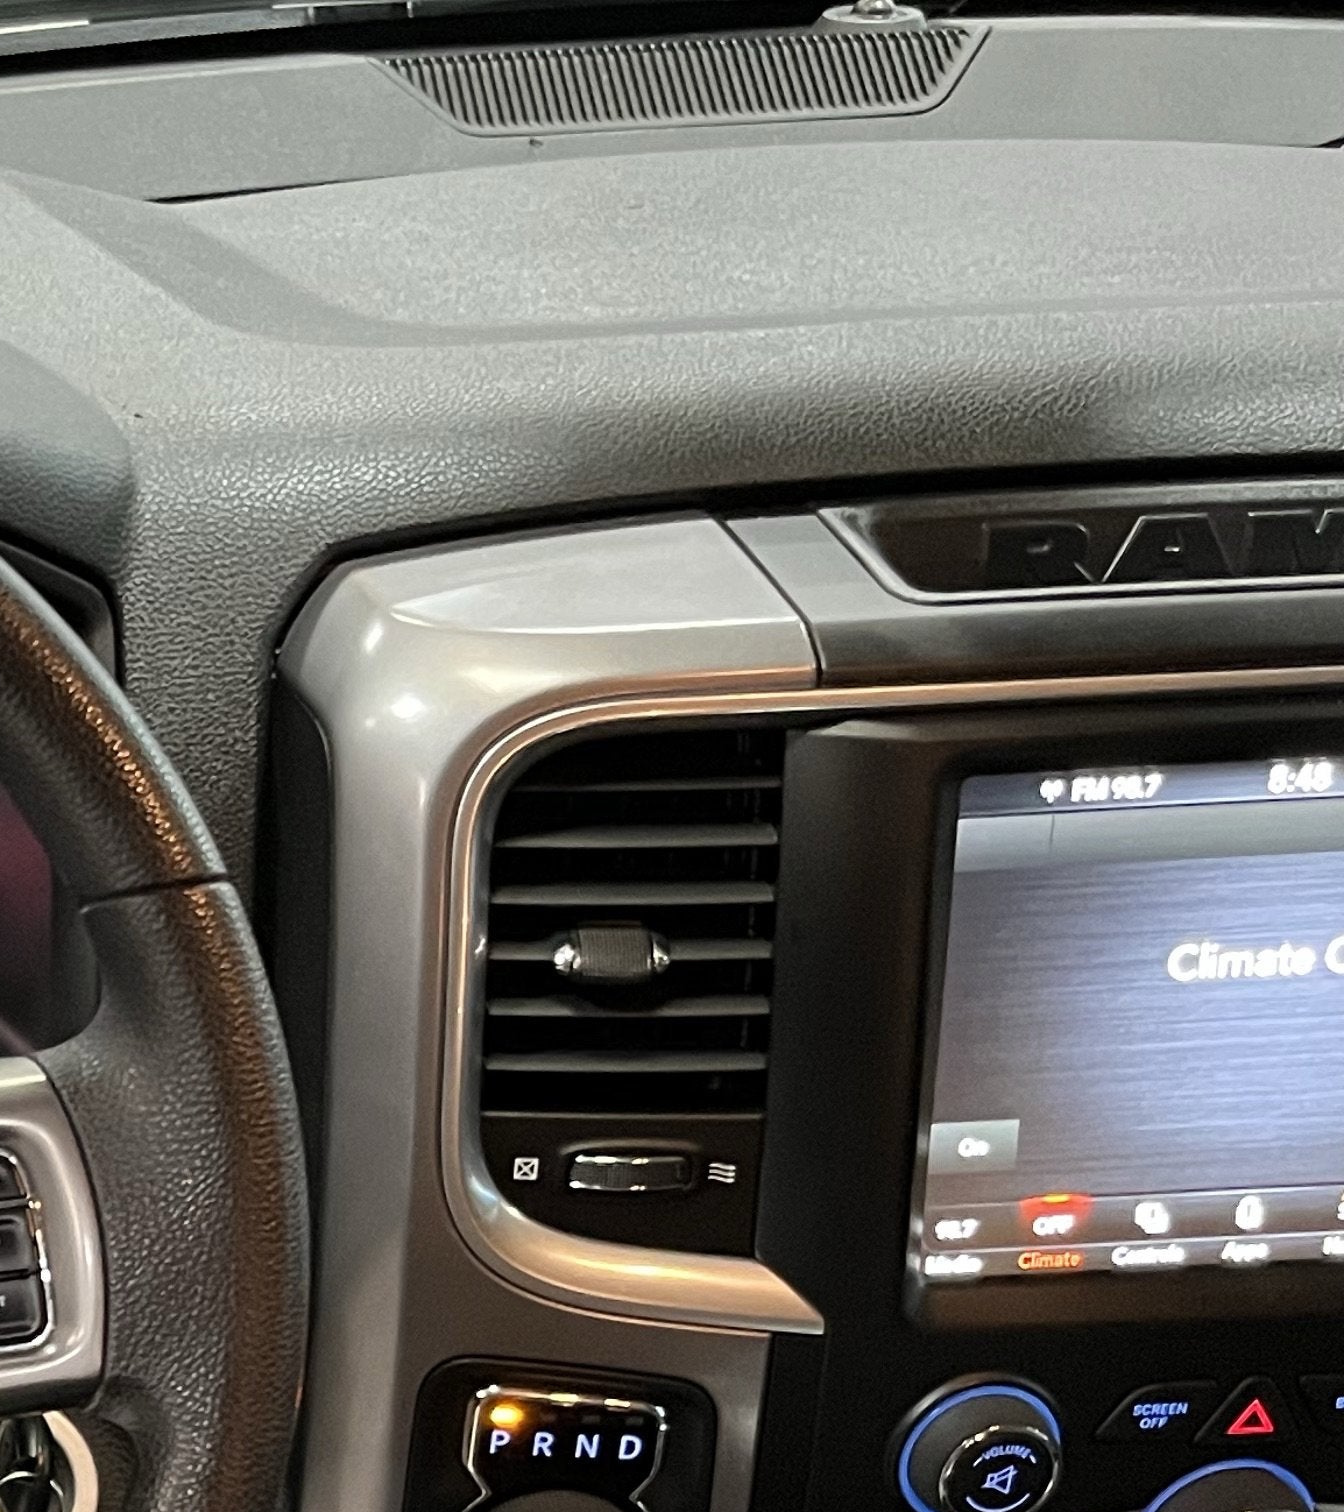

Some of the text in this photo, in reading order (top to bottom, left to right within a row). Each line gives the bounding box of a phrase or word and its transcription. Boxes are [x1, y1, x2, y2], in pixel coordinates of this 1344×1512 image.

[1070, 775, 1109, 802] FM
[1166, 941, 1316, 983] Climate
[1017, 1250, 1082, 1271] Climate
[1132, 1402, 1188, 1418] SCREEN
[1139, 1416, 1168, 1430] OFF
[489, 1428, 644, 1460] P R N D
[981, 1445, 1032, 1461] VOLUME
